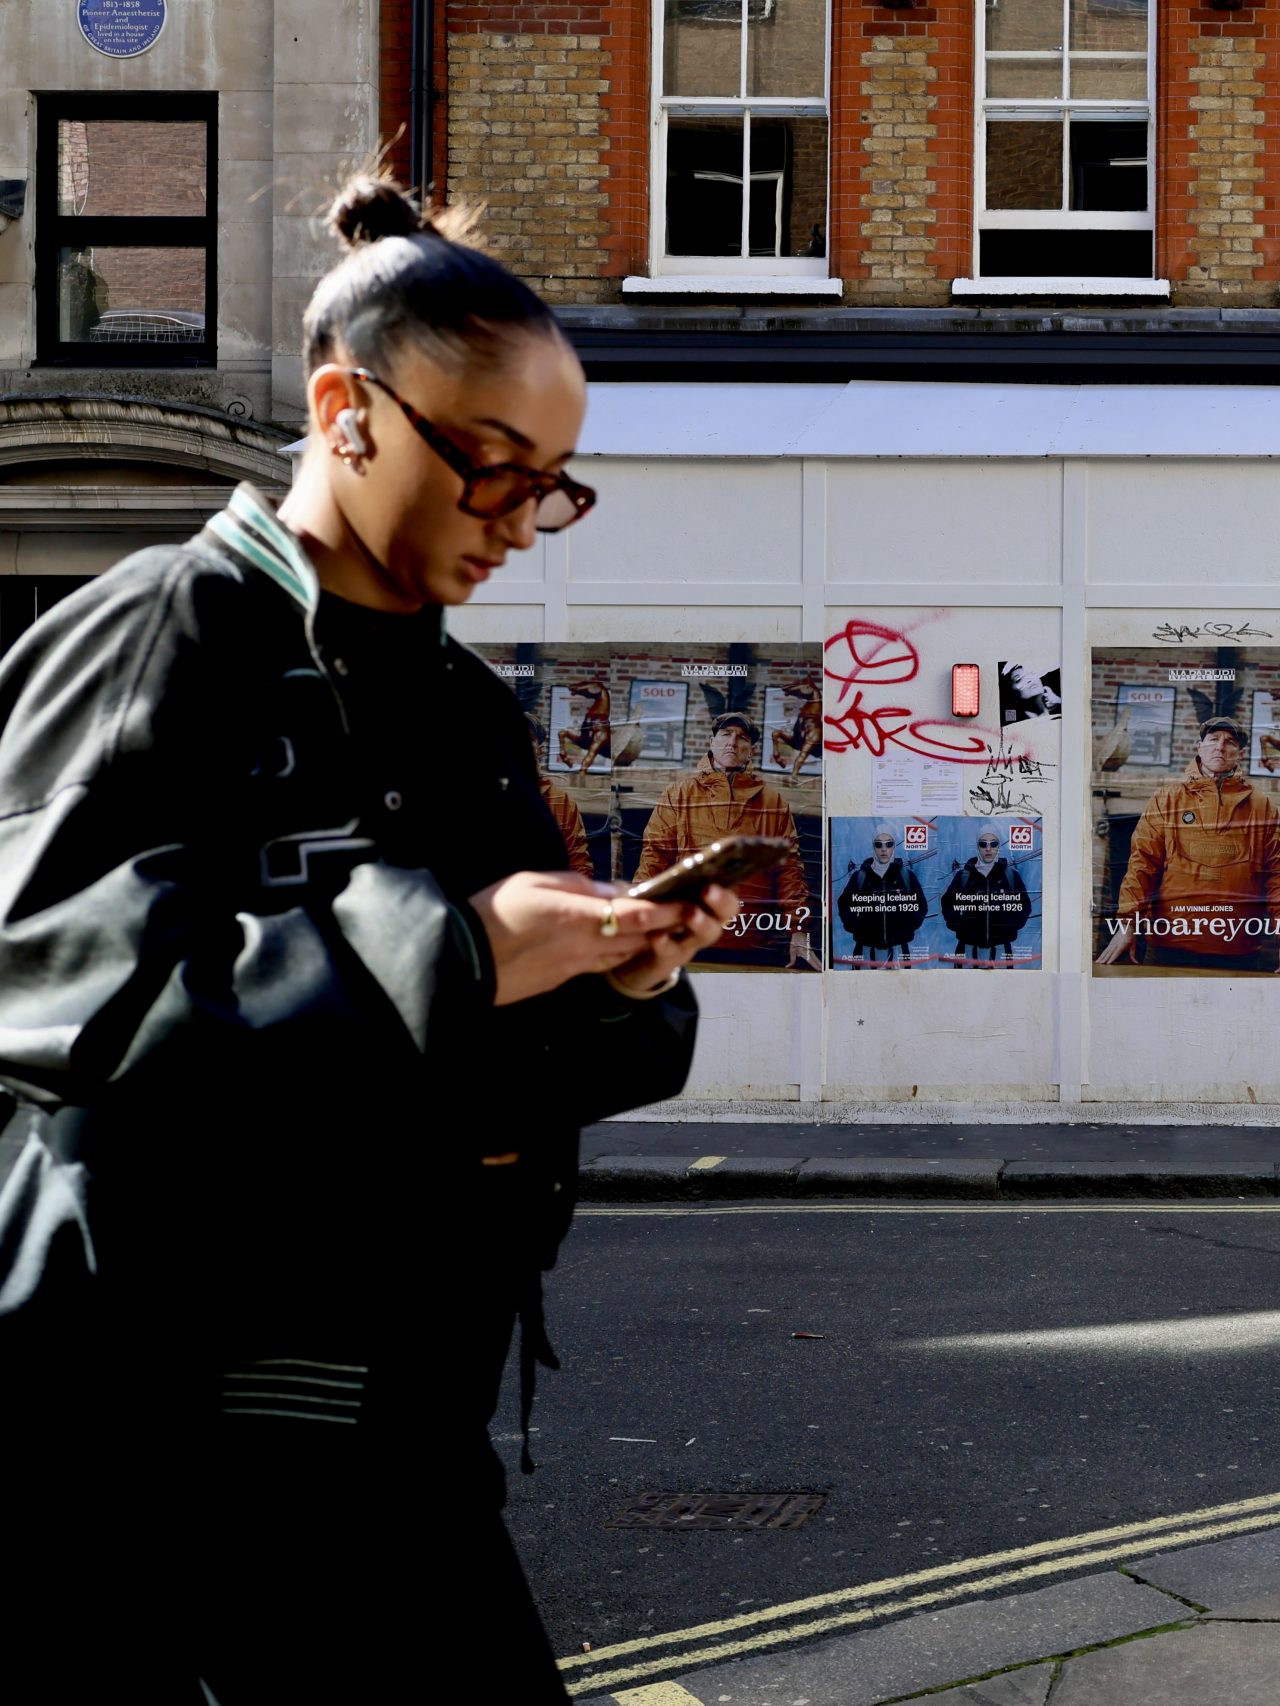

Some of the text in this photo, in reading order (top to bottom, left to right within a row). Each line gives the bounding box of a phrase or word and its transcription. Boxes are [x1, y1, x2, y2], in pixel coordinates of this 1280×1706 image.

[95, 23, 148, 31] Epidemiologist
[87, 33, 102, 48] GREAT
[104, 46, 127, 54] BRITAIN
[142, 24, 160, 46] IRELAND
[642, 687, 676, 698] SOLD
[1130, 692, 1164, 702] SOLD
[852, 893, 917, 904] Keeping Iceland
[955, 893, 1021, 903] Keeping Iceland
[874, 904, 897, 912] since
[898, 904, 919, 912] 1926
[978, 904, 1000, 912] since
[1002, 903, 1022, 911] 1926
[722, 906, 810, 937] eyou?
